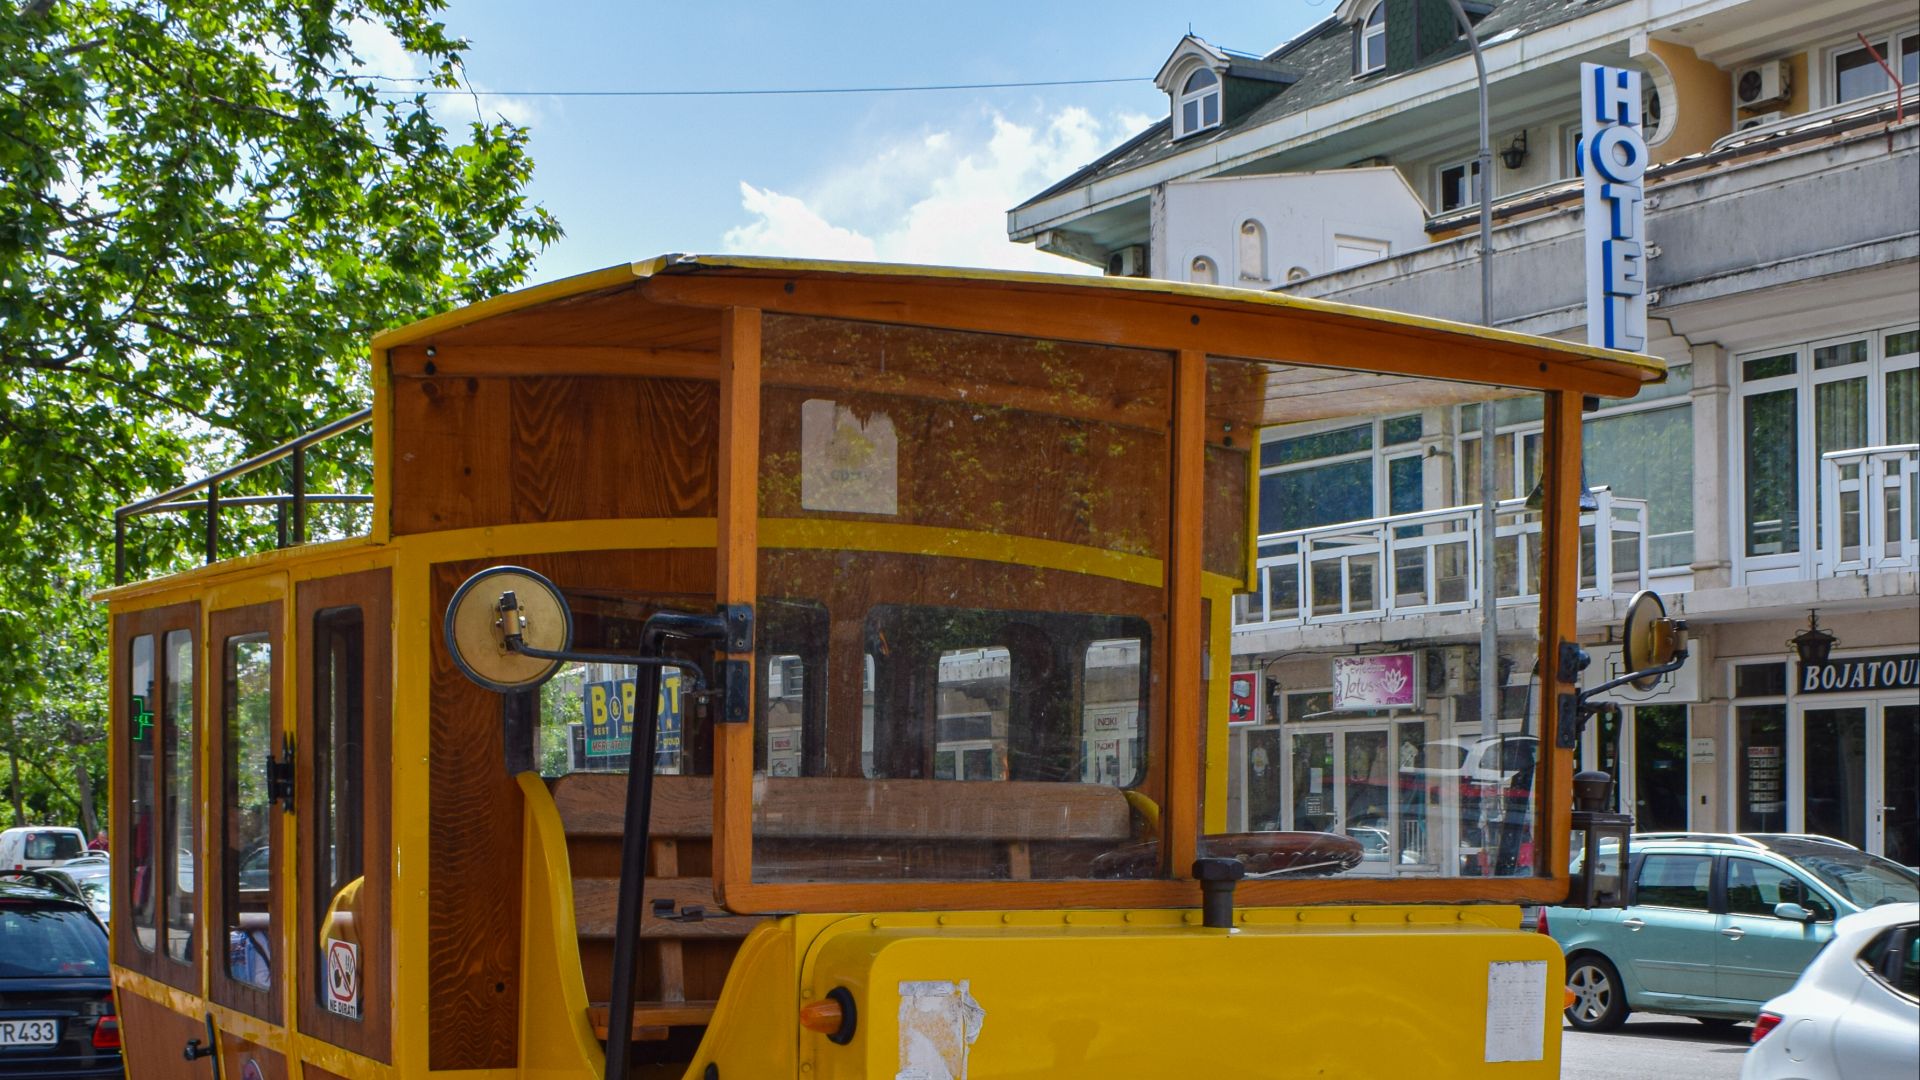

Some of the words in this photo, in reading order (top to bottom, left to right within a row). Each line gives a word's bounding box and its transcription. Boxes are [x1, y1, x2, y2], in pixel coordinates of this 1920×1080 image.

[1590, 66, 1648, 353] HOTEL
[1804, 659, 1919, 691] BOJATOU
[329, 999, 337, 1011] NE
[338, 1002, 356, 1018] DIRATI
